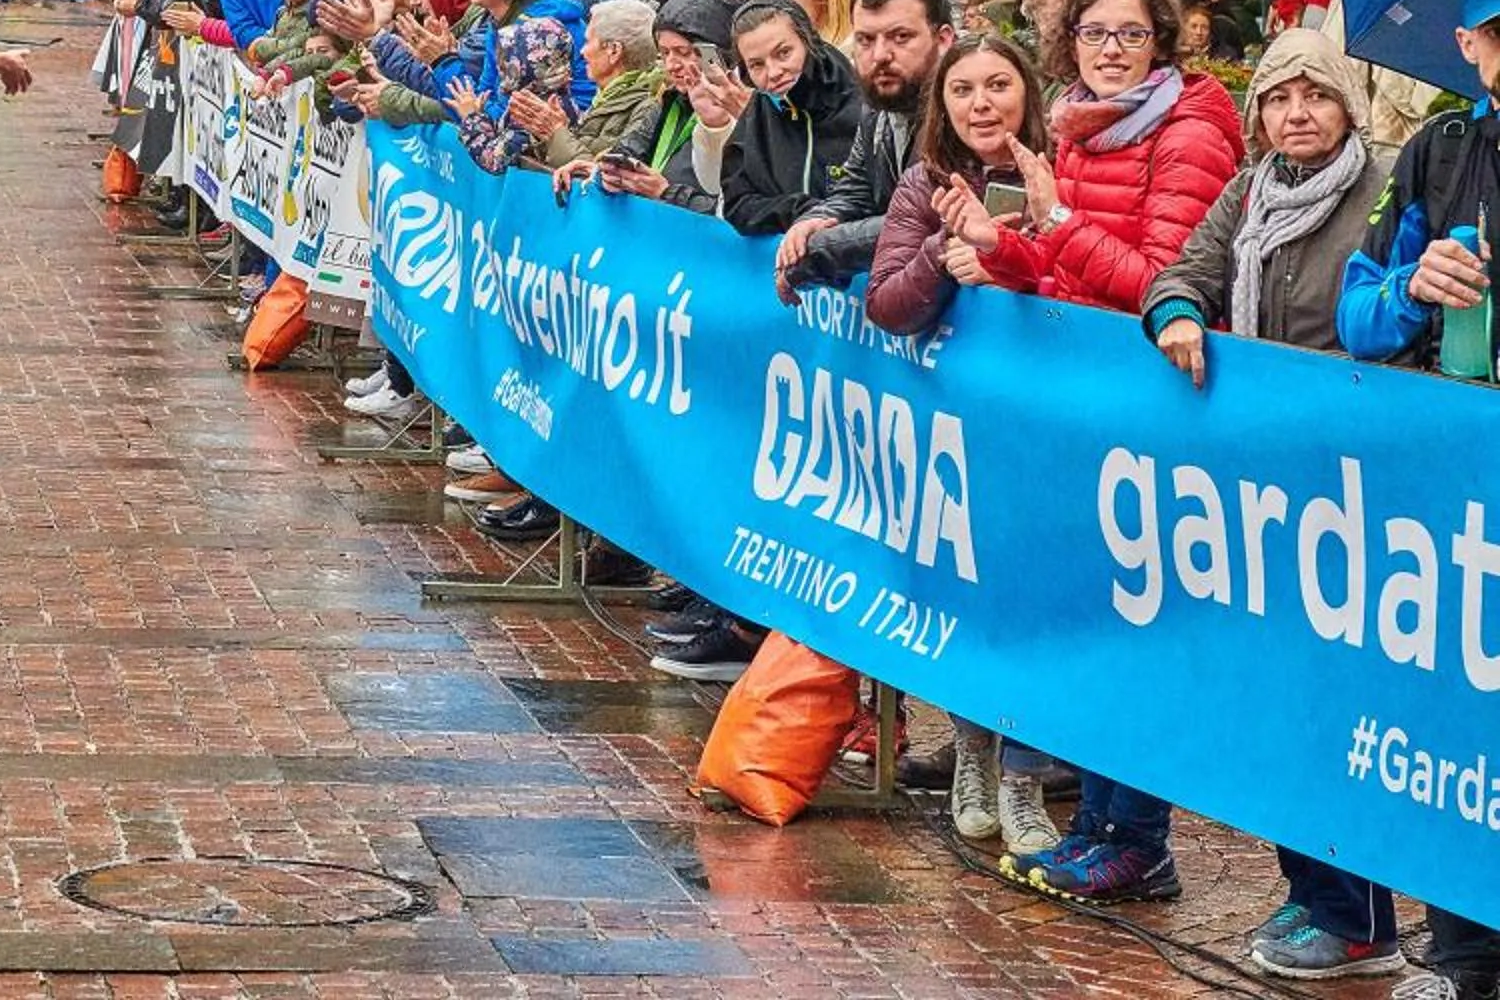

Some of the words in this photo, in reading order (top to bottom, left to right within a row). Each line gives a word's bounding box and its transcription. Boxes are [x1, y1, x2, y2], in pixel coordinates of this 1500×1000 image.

[753, 352, 978, 583] GARDA
[723, 526, 858, 614] TRENTINO
[859, 586, 959, 660] ITALY
